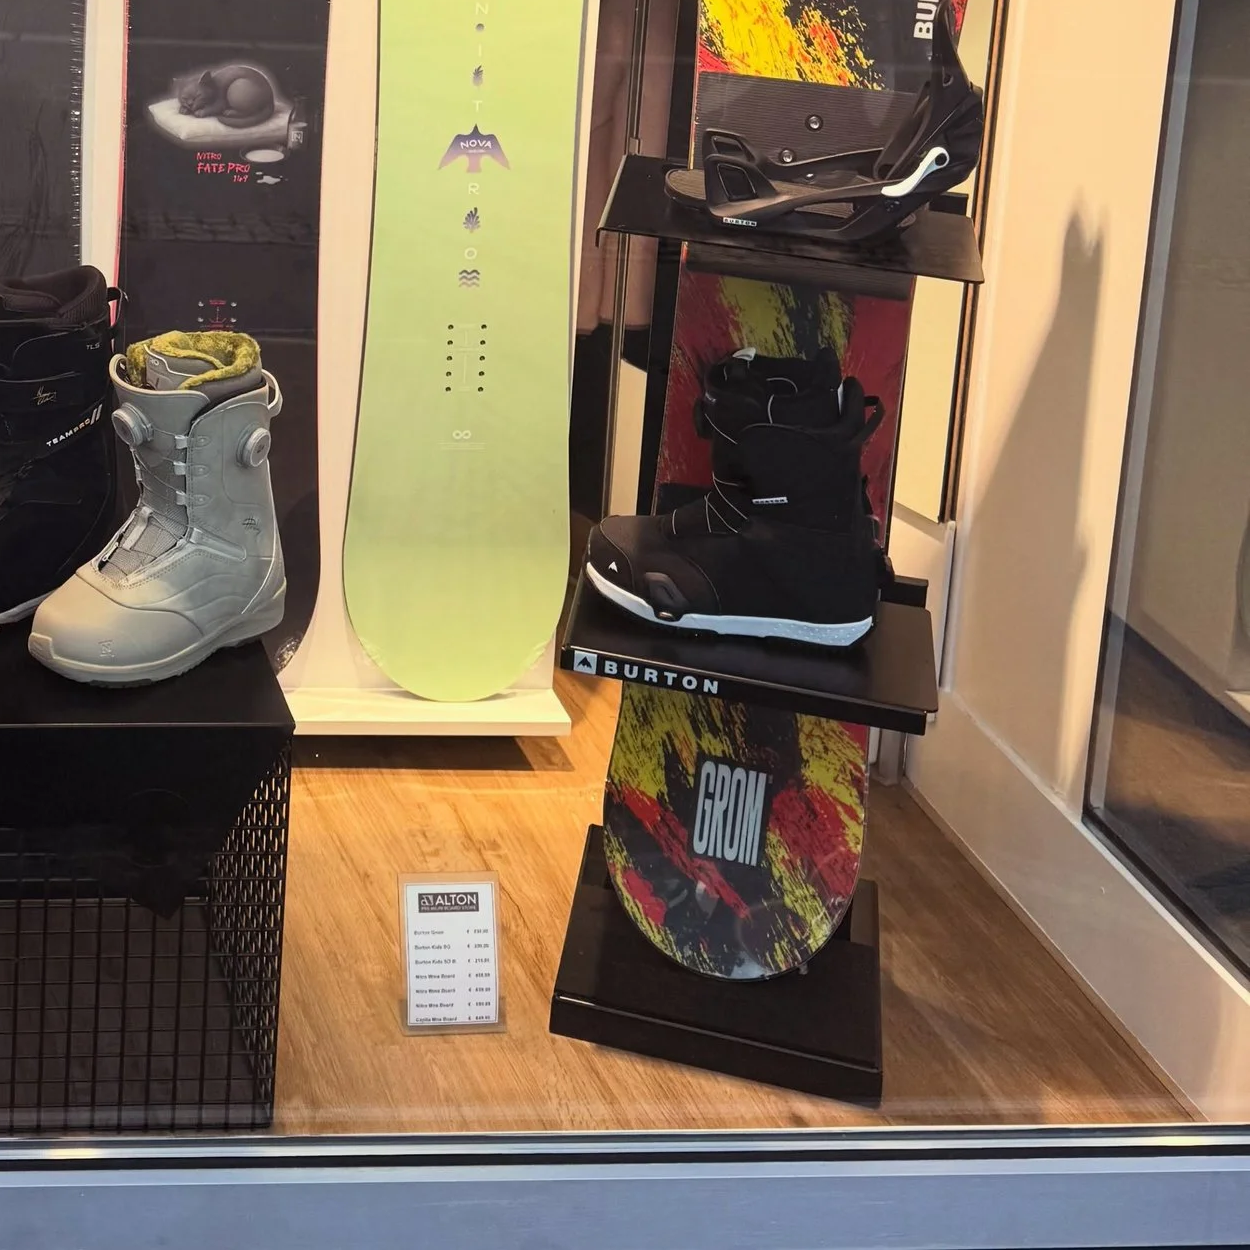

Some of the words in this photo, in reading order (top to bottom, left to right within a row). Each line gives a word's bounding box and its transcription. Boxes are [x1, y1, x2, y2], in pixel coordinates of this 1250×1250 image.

[460, 139, 492, 149] NOVA
[196, 152, 222, 161] NITRO
[197, 162, 226, 174] FATE
[227, 162, 250, 174] PRO
[86, 342, 100, 350] TLS
[604, 660, 719, 695] BURTON
[693, 760, 767, 867] GROM
[435, 894, 477, 905] ALTON
